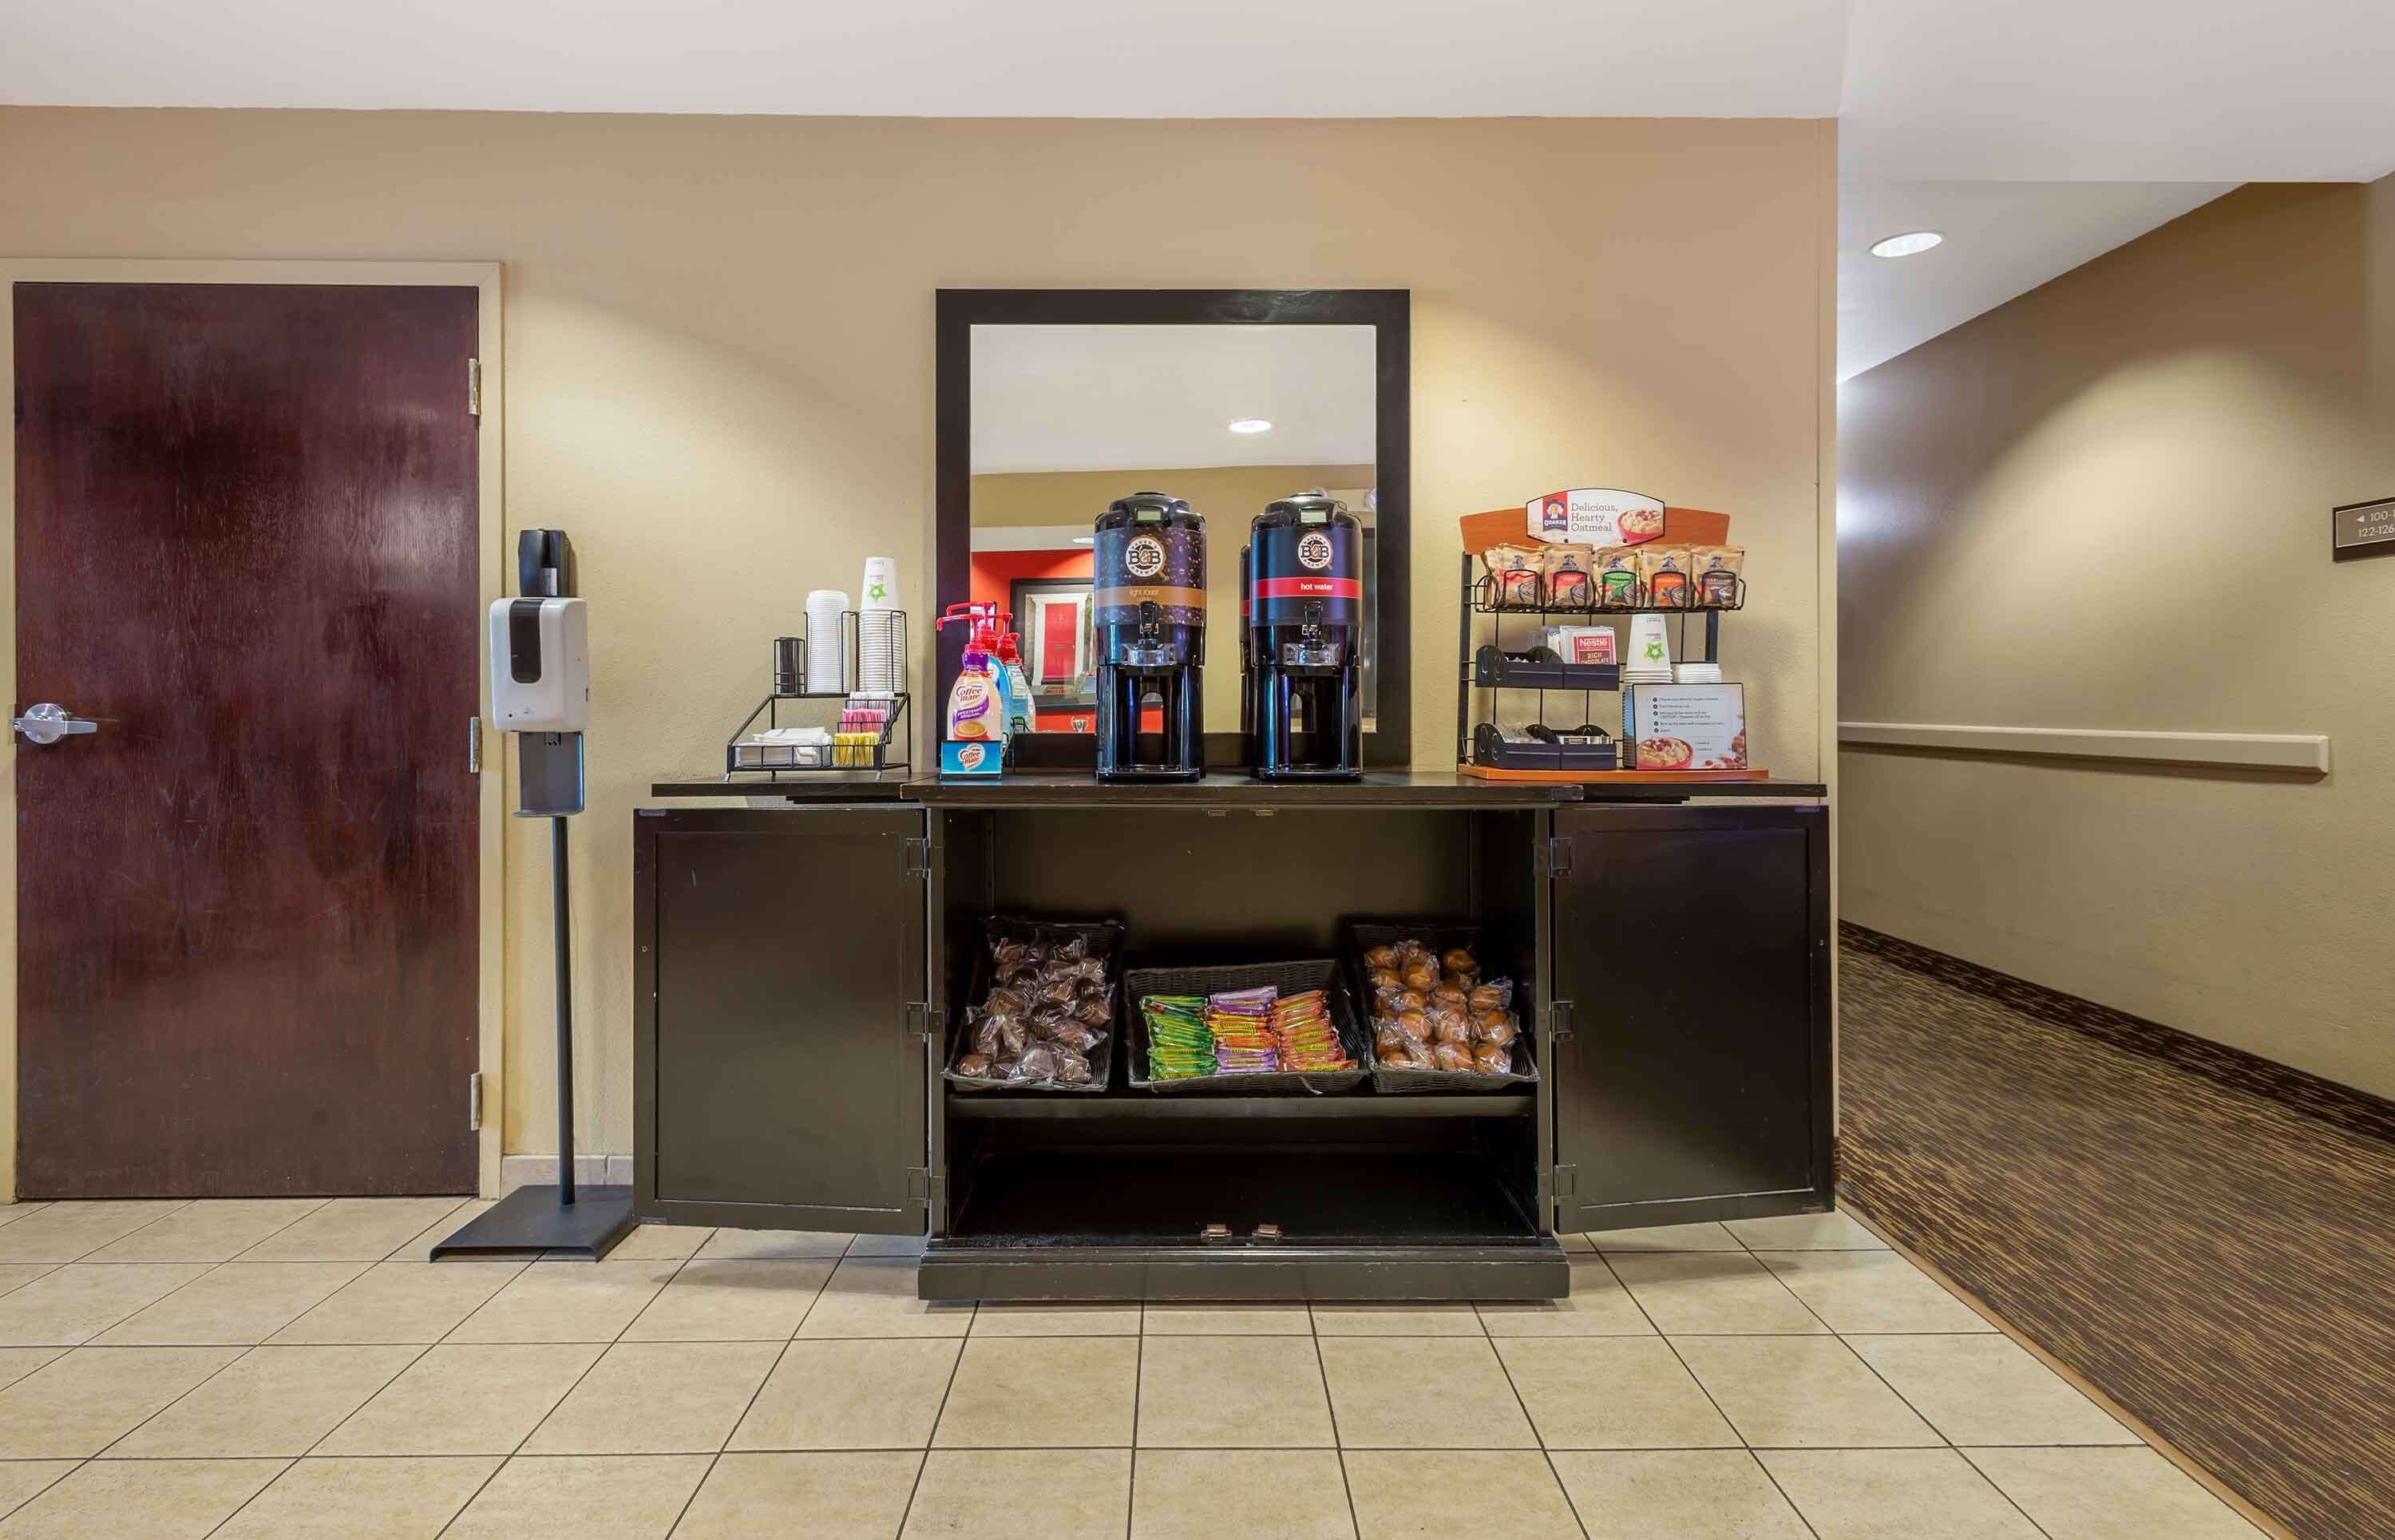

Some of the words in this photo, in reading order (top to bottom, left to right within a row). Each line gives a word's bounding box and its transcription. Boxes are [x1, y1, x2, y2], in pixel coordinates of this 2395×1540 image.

[1570, 502, 1618, 513] Delicious,
[1570, 513, 1605, 524] Hearty
[1570, 522, 1612, 532] Oatmeal
[2357, 524, 2395, 537] 122-126
[956, 687, 983, 697] Coffee
[960, 750, 981, 760] Coffee
